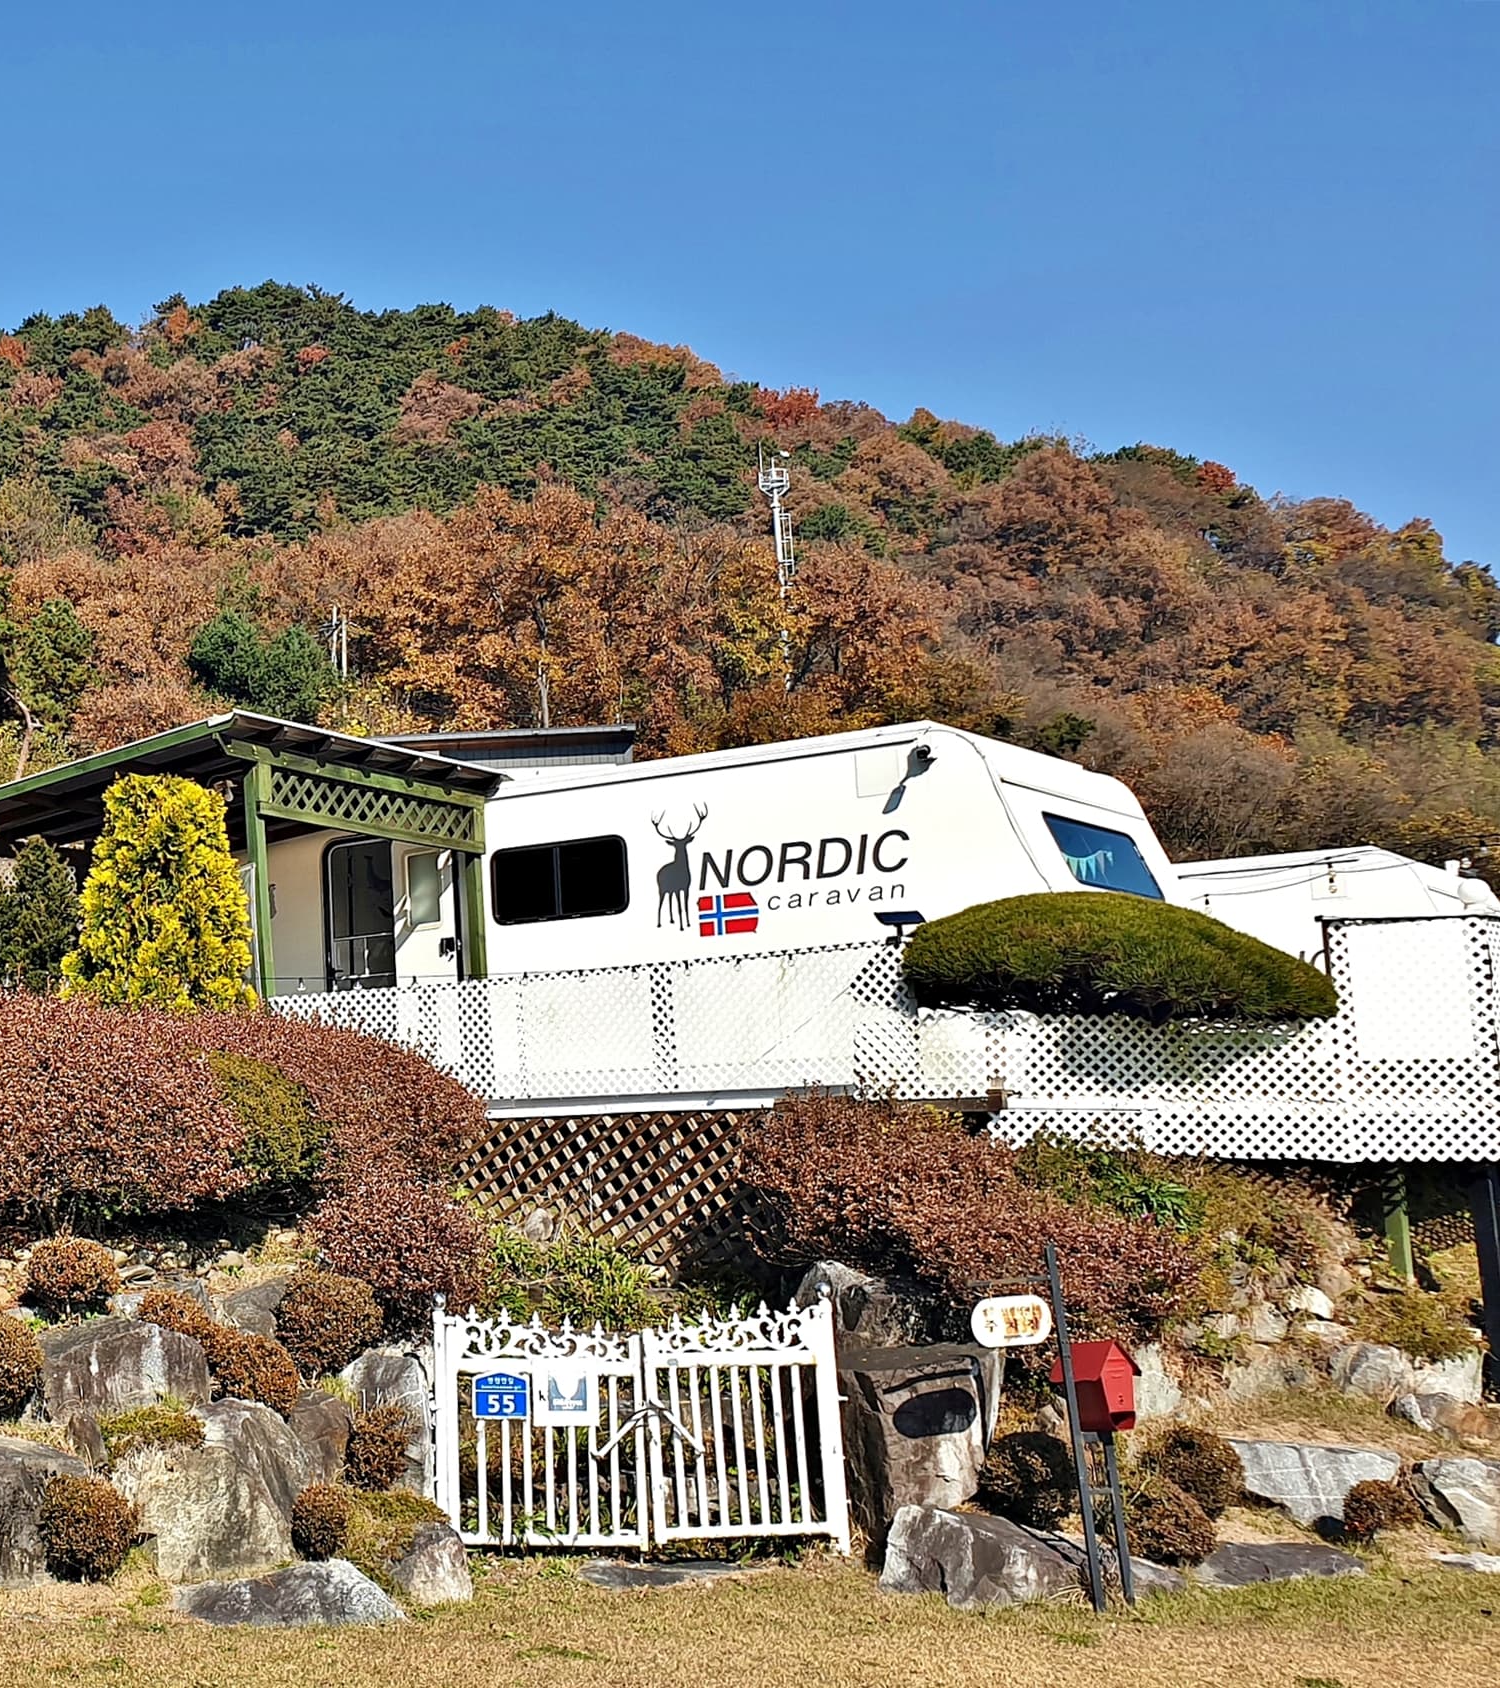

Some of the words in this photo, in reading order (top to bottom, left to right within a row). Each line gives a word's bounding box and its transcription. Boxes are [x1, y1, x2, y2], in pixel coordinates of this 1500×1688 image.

[700, 829, 910, 890] NORDIC
[767, 883, 906, 911] caravan
[487, 1394, 516, 1414] 55
